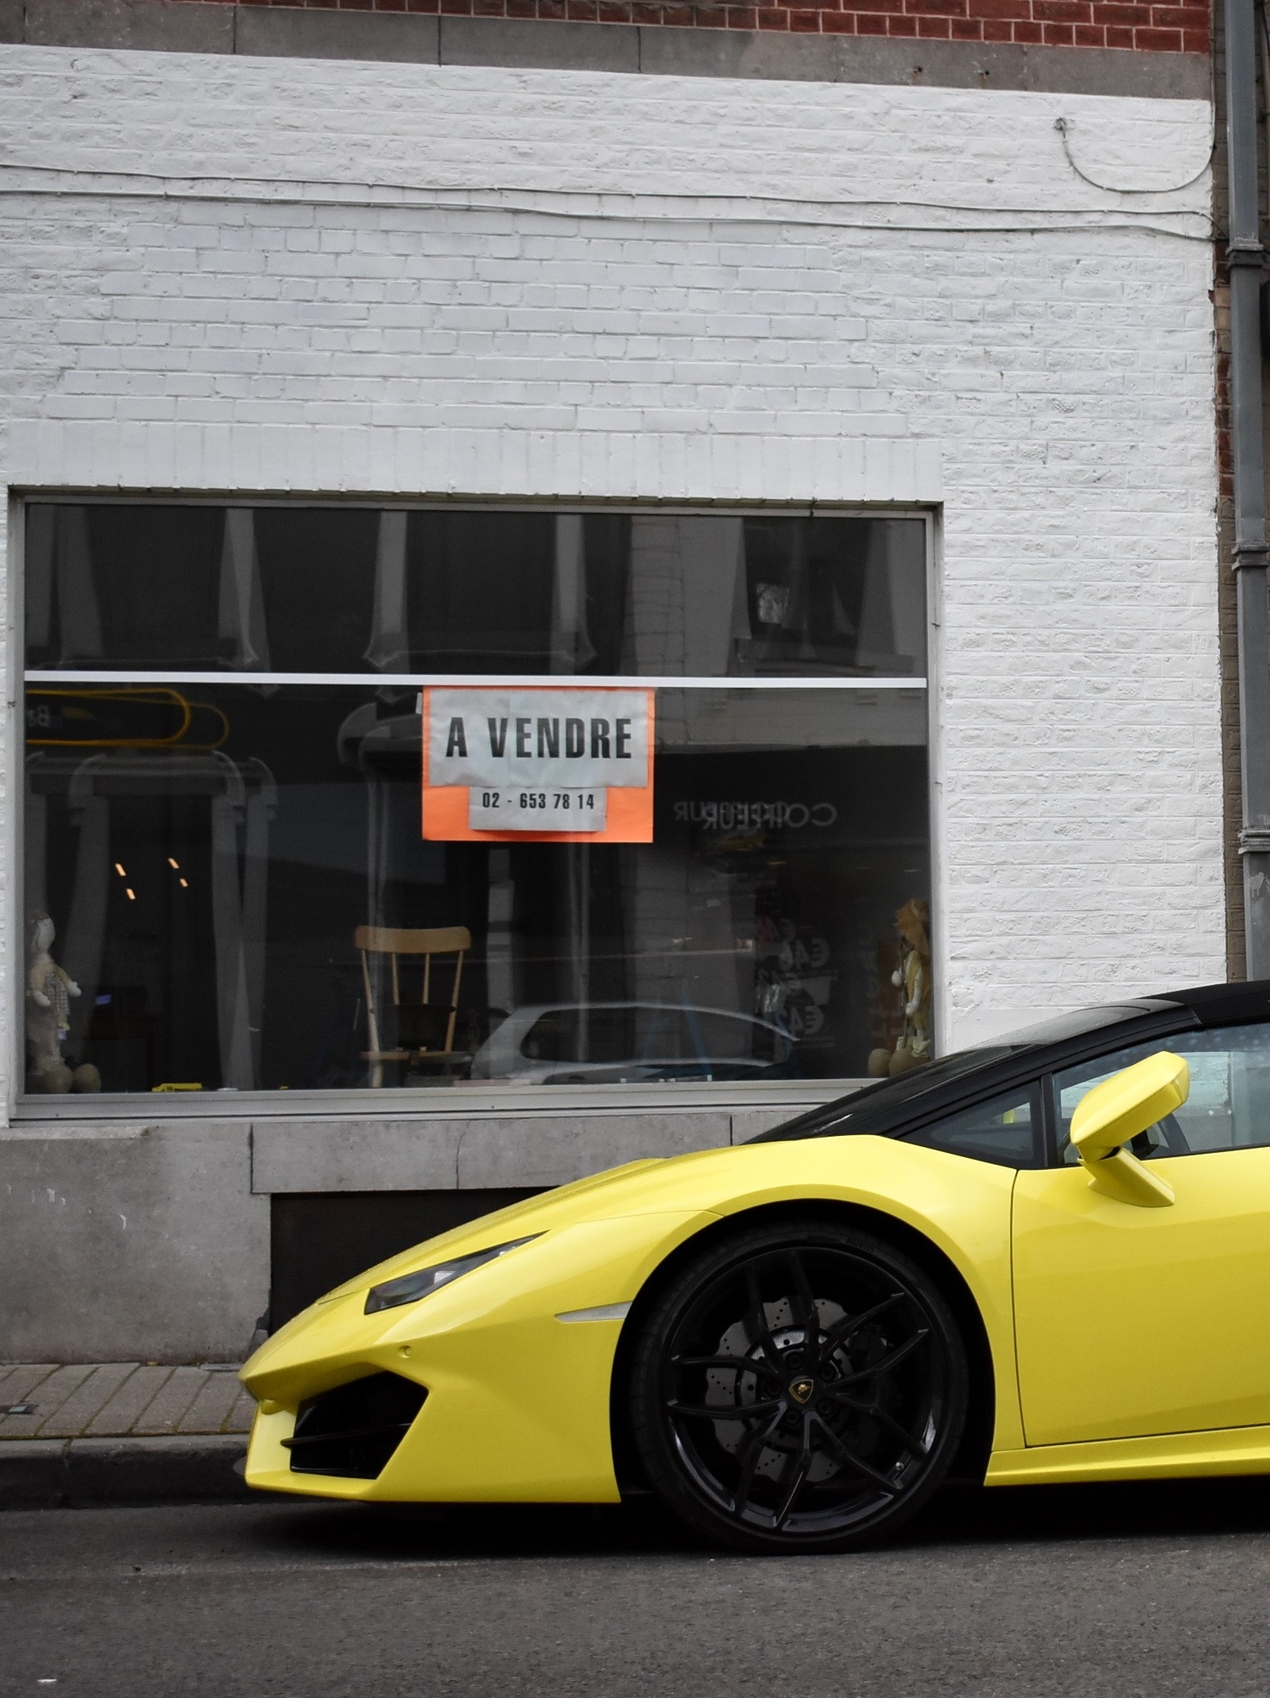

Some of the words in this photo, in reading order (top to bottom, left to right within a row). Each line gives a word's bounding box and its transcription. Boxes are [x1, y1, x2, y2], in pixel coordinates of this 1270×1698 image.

[445, 717, 468, 758] A
[487, 717, 632, 759] VENDRE
[482, 792, 500, 808] 02
[519, 793, 546, 809] 653
[553, 794, 570, 810] 78
[578, 794, 595, 810] 14
